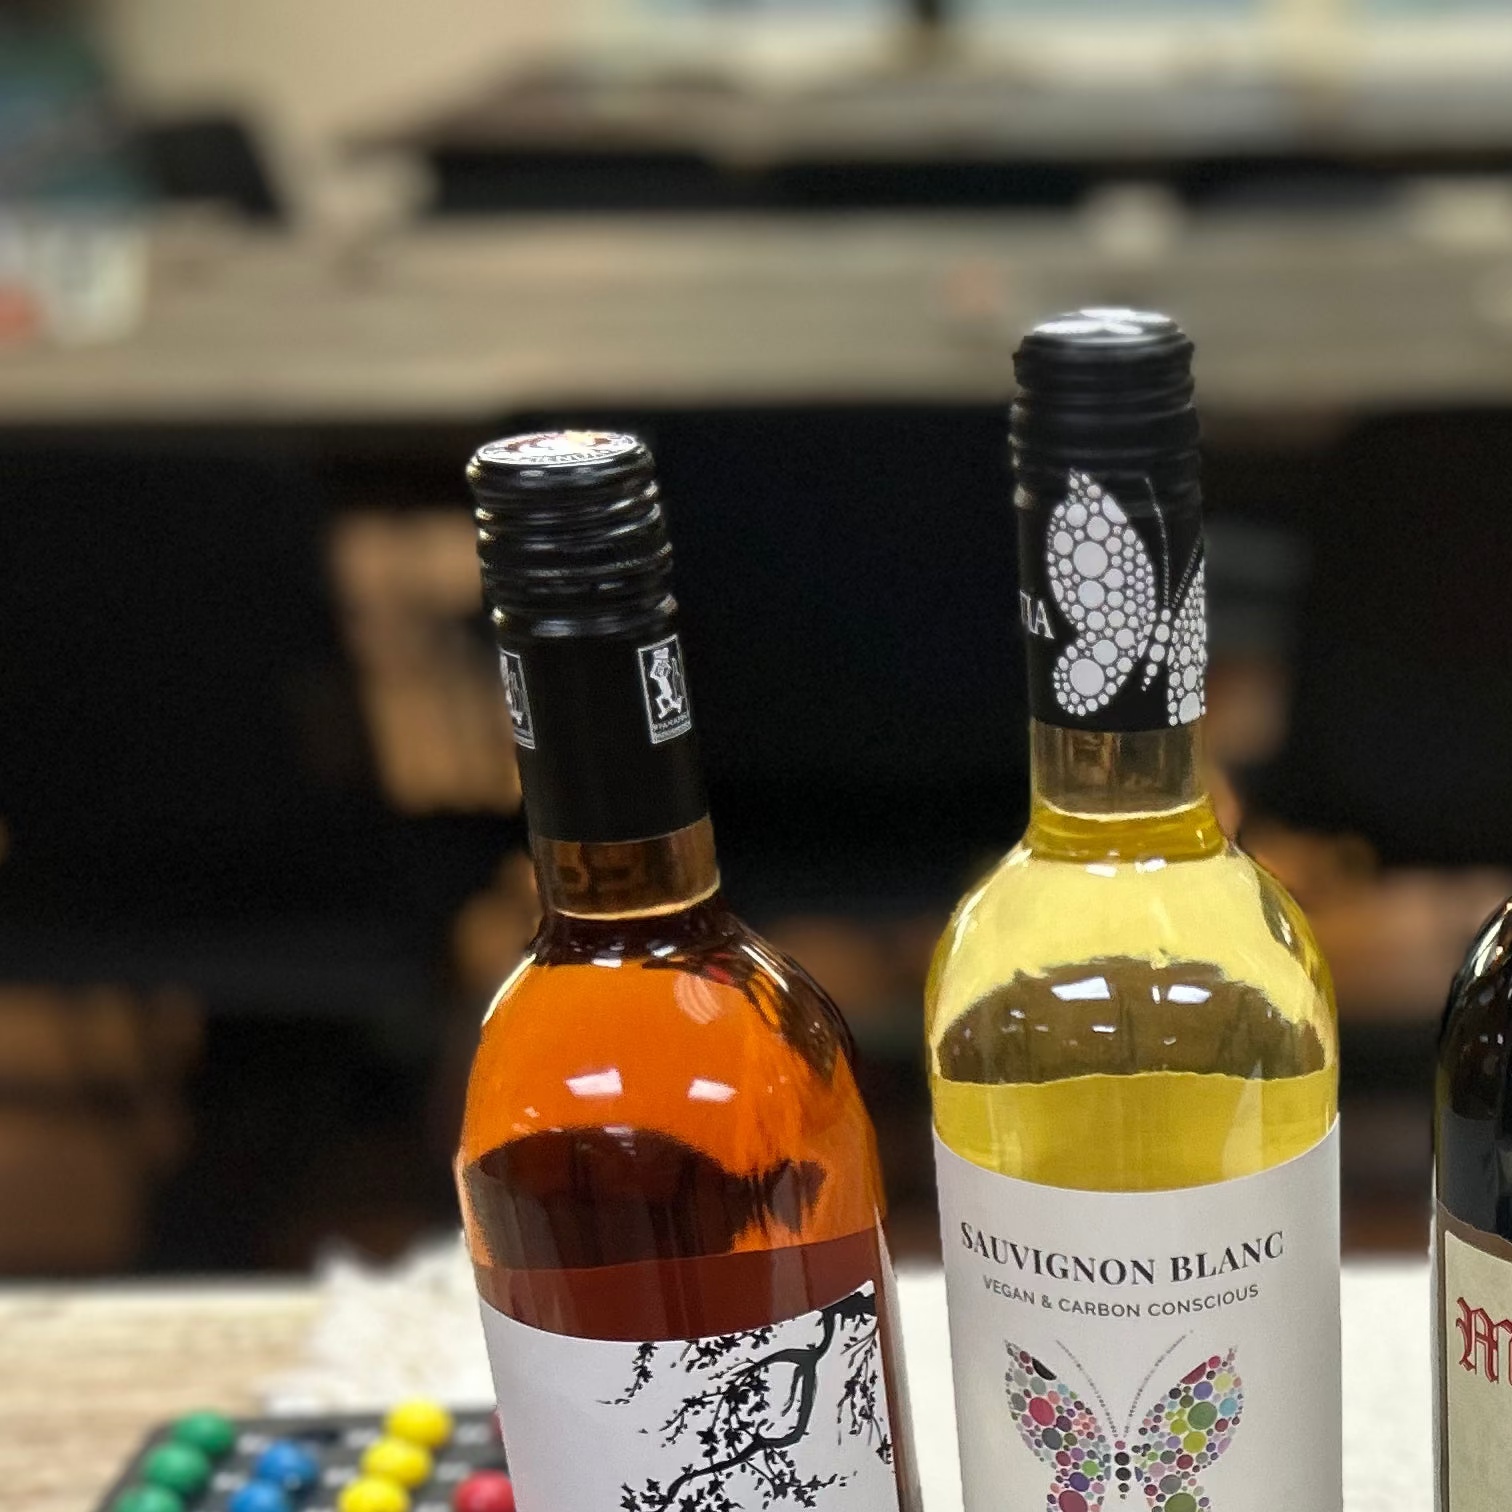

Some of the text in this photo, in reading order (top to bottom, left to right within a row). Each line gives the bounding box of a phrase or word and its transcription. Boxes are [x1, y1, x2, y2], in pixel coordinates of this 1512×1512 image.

[960, 1221, 1285, 1286] SAUVIGNON BLANC
[982, 1274, 1259, 1318] VEGAN & CARBON CONSCIOUS
